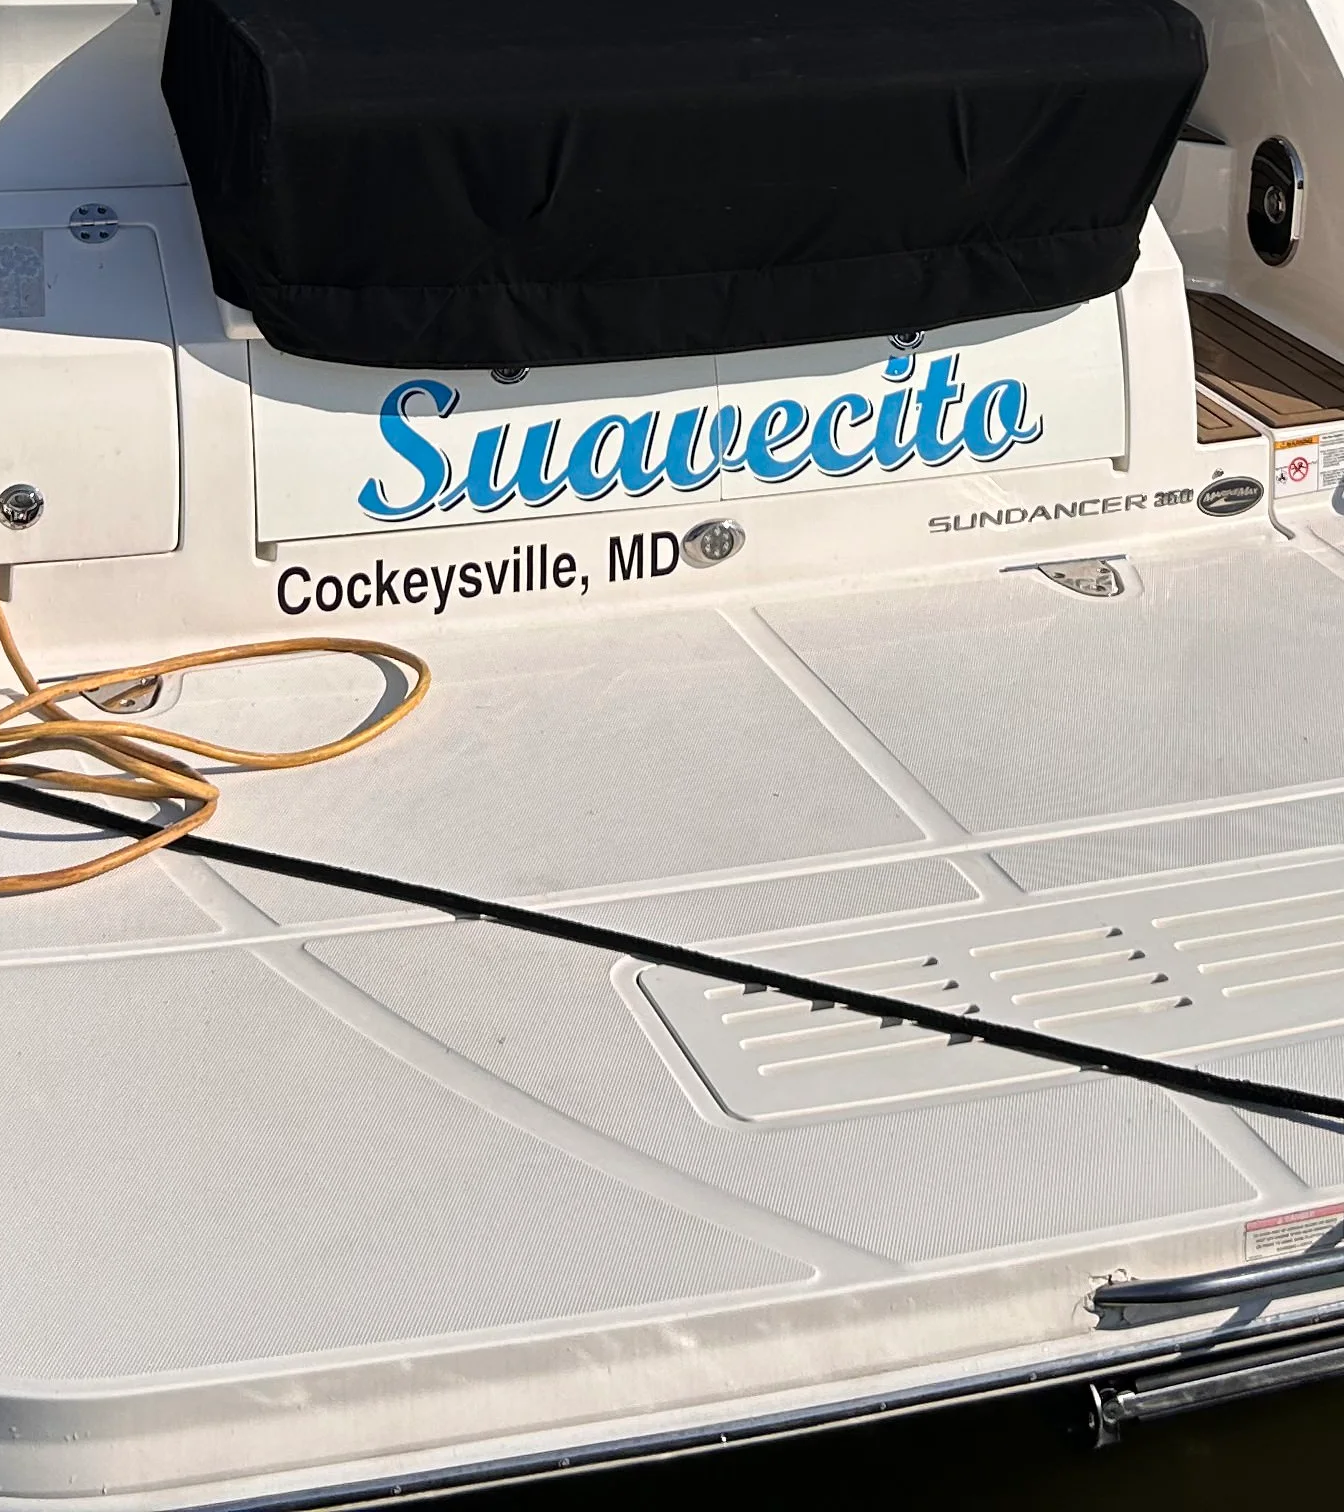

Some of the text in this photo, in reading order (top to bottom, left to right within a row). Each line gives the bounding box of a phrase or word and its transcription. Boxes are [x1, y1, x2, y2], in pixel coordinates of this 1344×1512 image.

[357, 351, 1043, 523] Suavecito
[928, 493, 1147, 534] SUNDANCER
[276, 530, 680, 616] Cockeysville, MD
